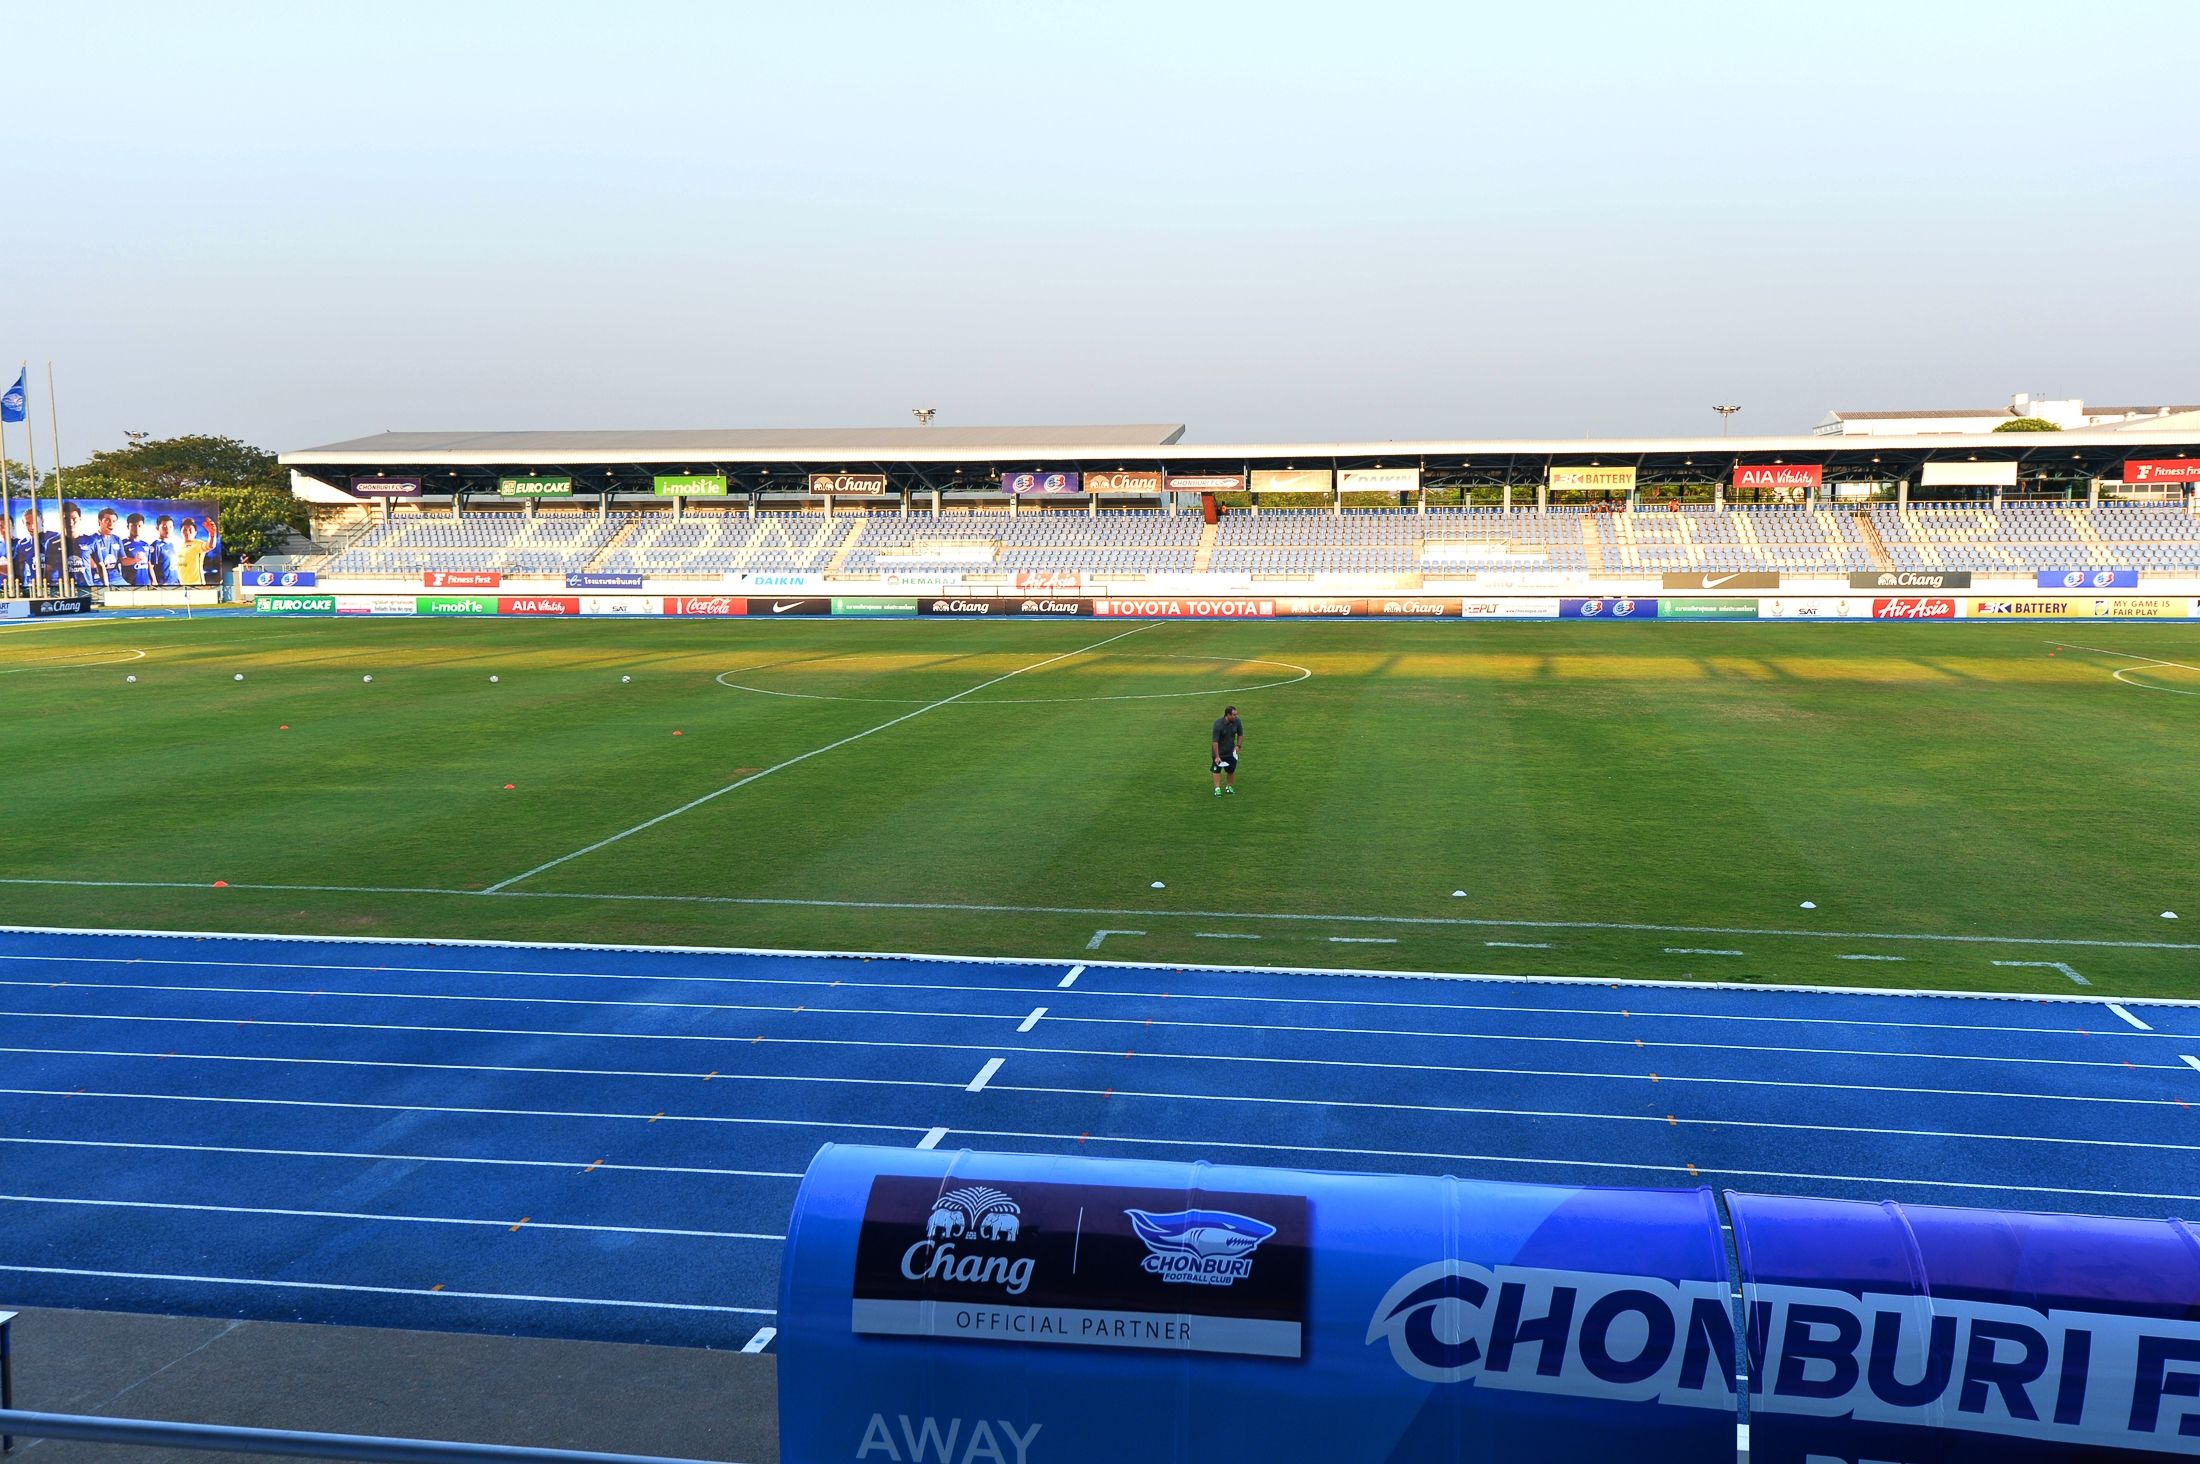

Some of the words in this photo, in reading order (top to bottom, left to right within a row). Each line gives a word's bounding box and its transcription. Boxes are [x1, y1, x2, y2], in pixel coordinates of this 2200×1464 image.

[1110, 475, 1157, 491] Chang
[1585, 474, 1632, 484] BATTERY
[1741, 470, 1774, 484] AIA
[1776, 469, 1813, 485] Vitality
[516, 482, 543, 493] EURO
[543, 482, 570, 493] CAKE
[663, 479, 720, 494] i-mobile
[835, 476, 881, 494] Chang
[755, 577, 805, 585] DAIKIN
[1898, 572, 1943, 588] Chang
[53, 600, 81, 613] Chang
[272, 600, 302, 610] EURO
[302, 600, 332, 610] CAKE
[431, 600, 483, 613] i-mobile
[512, 600, 537, 611] AIA
[538, 599, 566, 614] Vitality
[950, 600, 989, 614] Chang
[1039, 600, 1078, 614] Chang
[1111, 601, 1181, 615] TOYOTA
[1187, 601, 1258, 615] TOYOTA
[1311, 600, 1351, 615] Chang
[1402, 601, 1444, 616] Chang
[2015, 603, 2068, 614] BATTERY
[901, 1239, 1036, 1295] Chang
[1141, 1254, 1252, 1277] CHONBURI
[1164, 1272, 1208, 1283] FOOTBALL
[1209, 1275, 1232, 1285] CLUB
[956, 1310, 1069, 1336] OFFICIAL
[1081, 1317, 1192, 1341] PARTNER
[1381, 1272, 2093, 1427] CHONBURI
[856, 1412, 1043, 1464] AWAY
